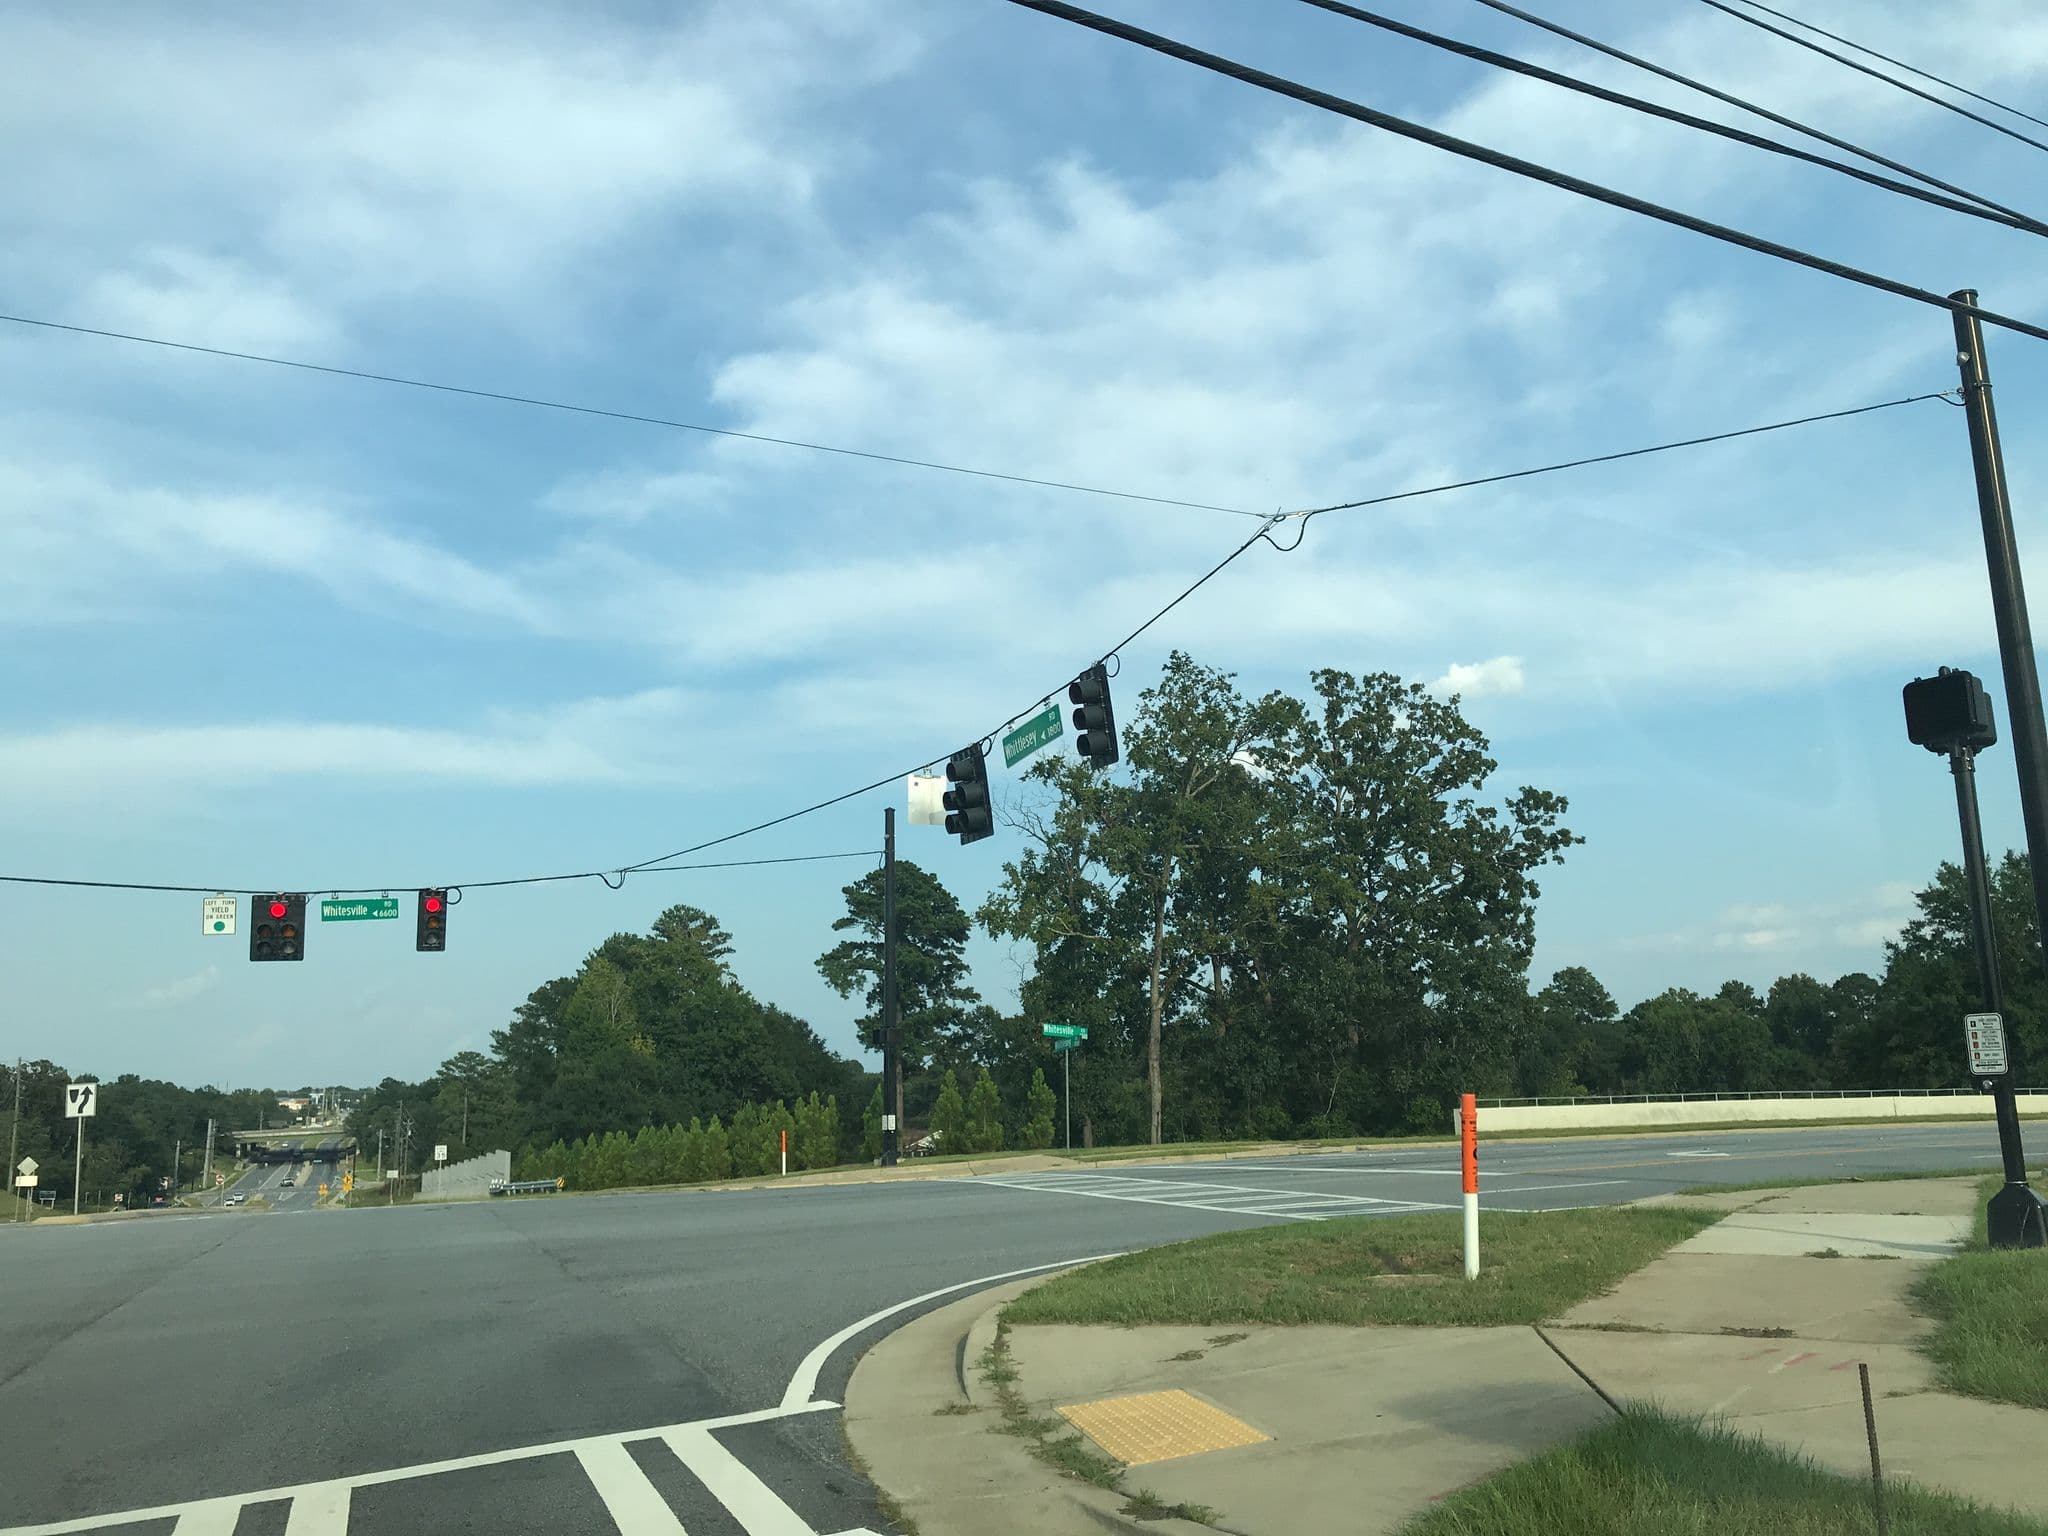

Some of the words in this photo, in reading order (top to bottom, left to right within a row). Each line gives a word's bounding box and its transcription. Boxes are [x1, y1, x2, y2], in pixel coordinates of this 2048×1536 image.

[1049, 711, 1056, 721] RD
[1004, 731, 1037, 760] Whittlesey
[323, 905, 368, 917] Whitesville
[379, 909, 398, 917] 6600
[1043, 1023, 1074, 1036] Whitesville
